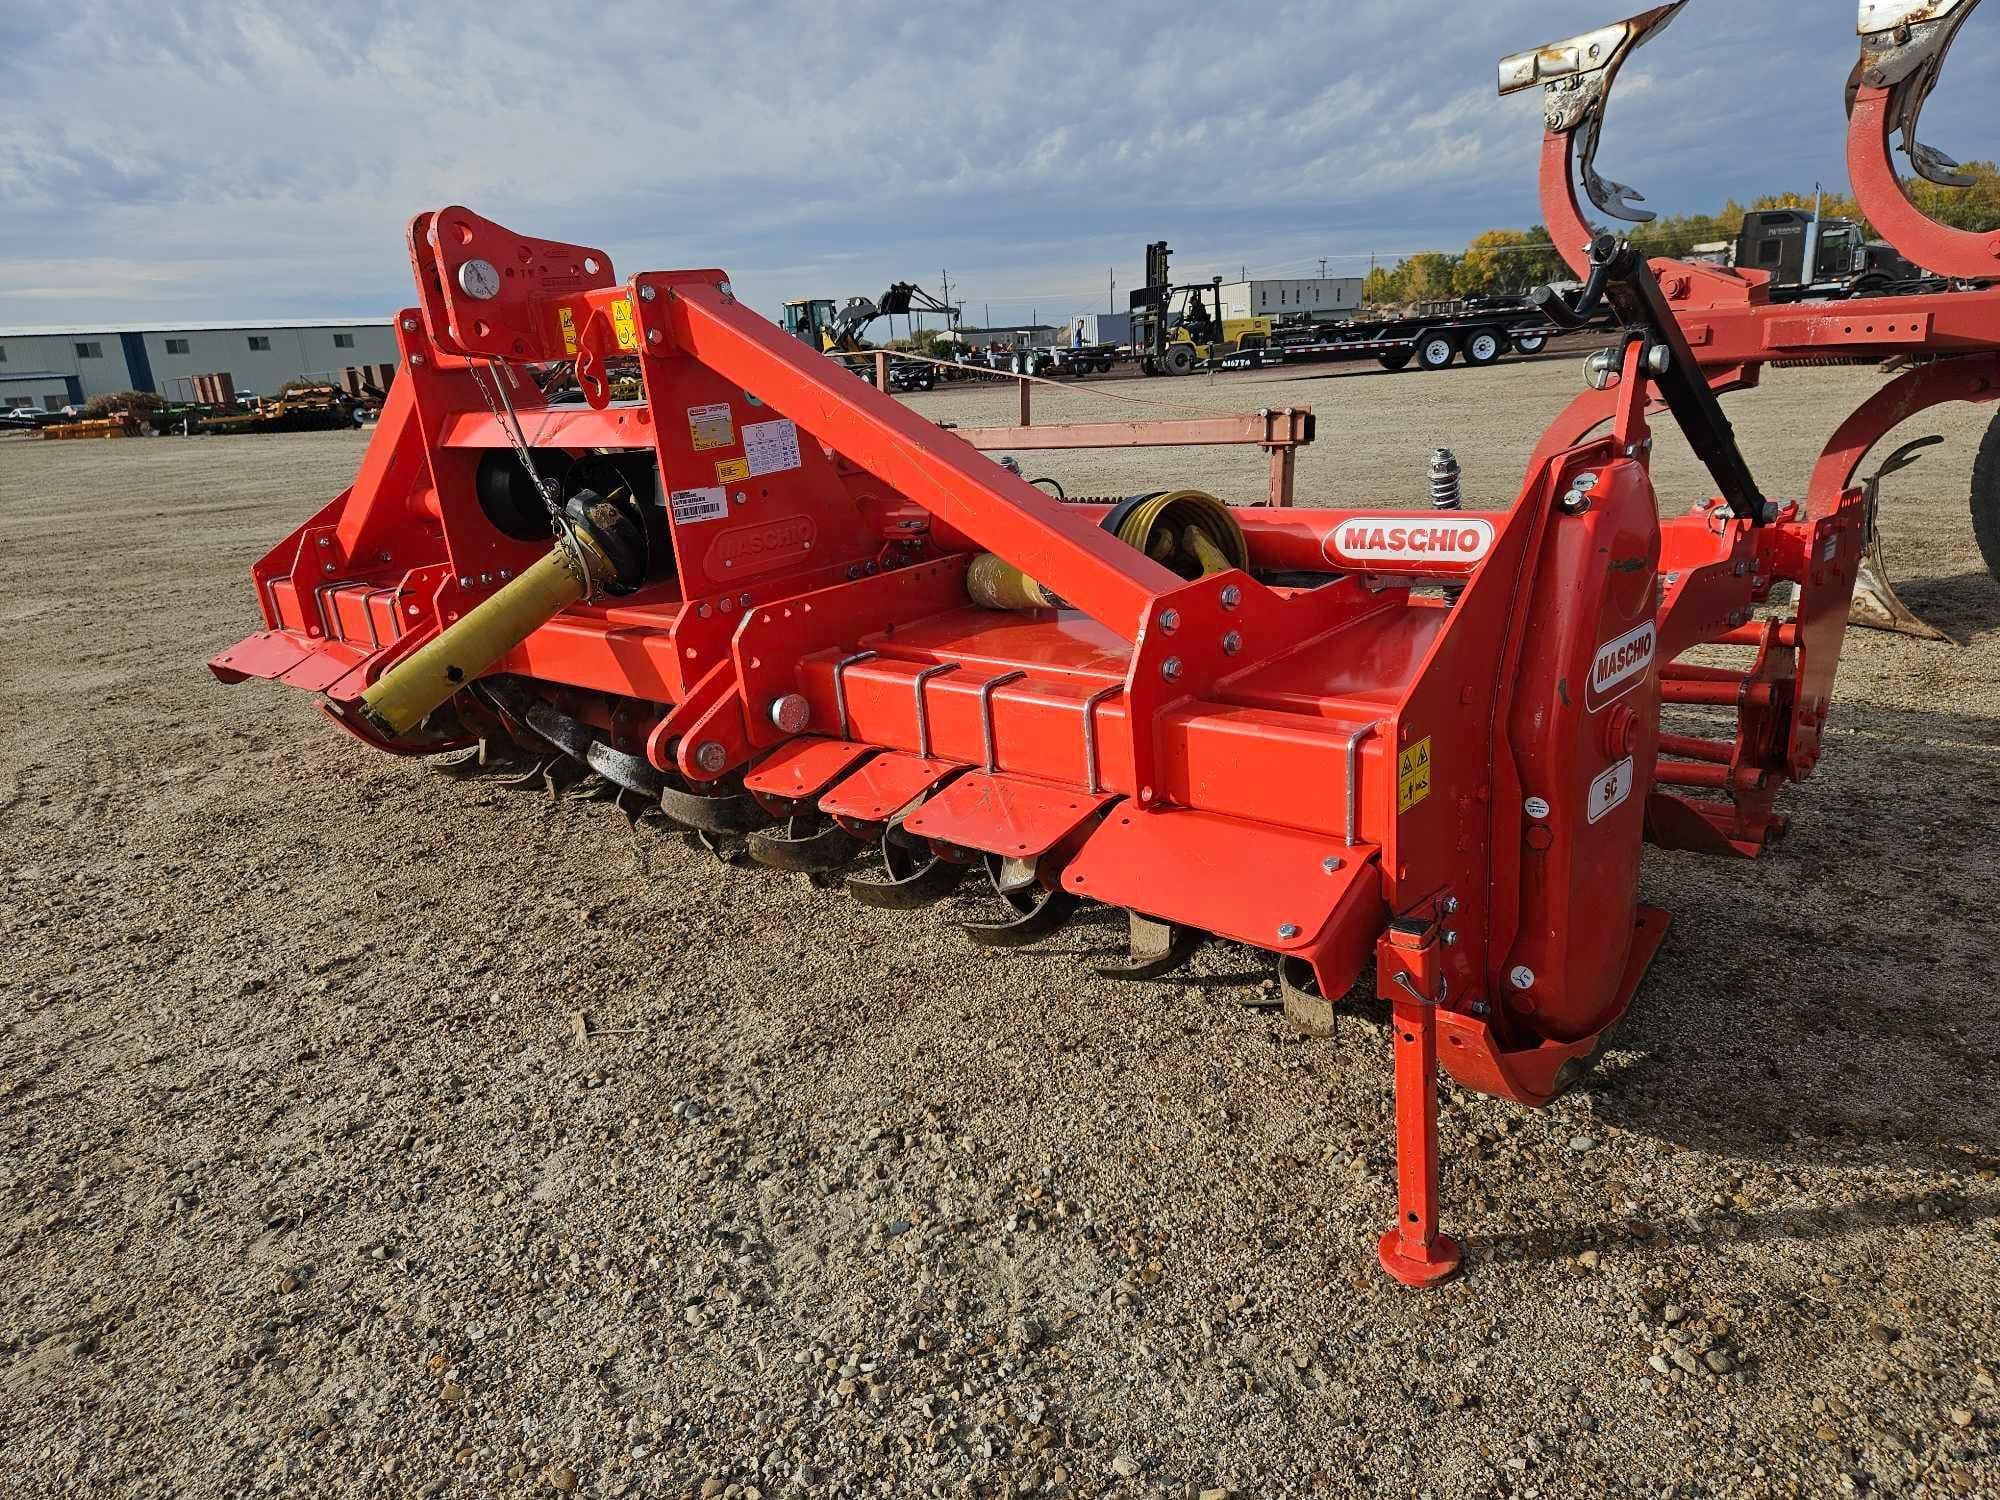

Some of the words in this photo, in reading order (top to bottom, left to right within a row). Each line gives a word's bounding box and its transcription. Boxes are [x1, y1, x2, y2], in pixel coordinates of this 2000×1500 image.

[1344, 528, 1481, 552] MASCHIO
[1597, 632, 1652, 684] MASCHIO
[1604, 777, 1618, 801] SC
